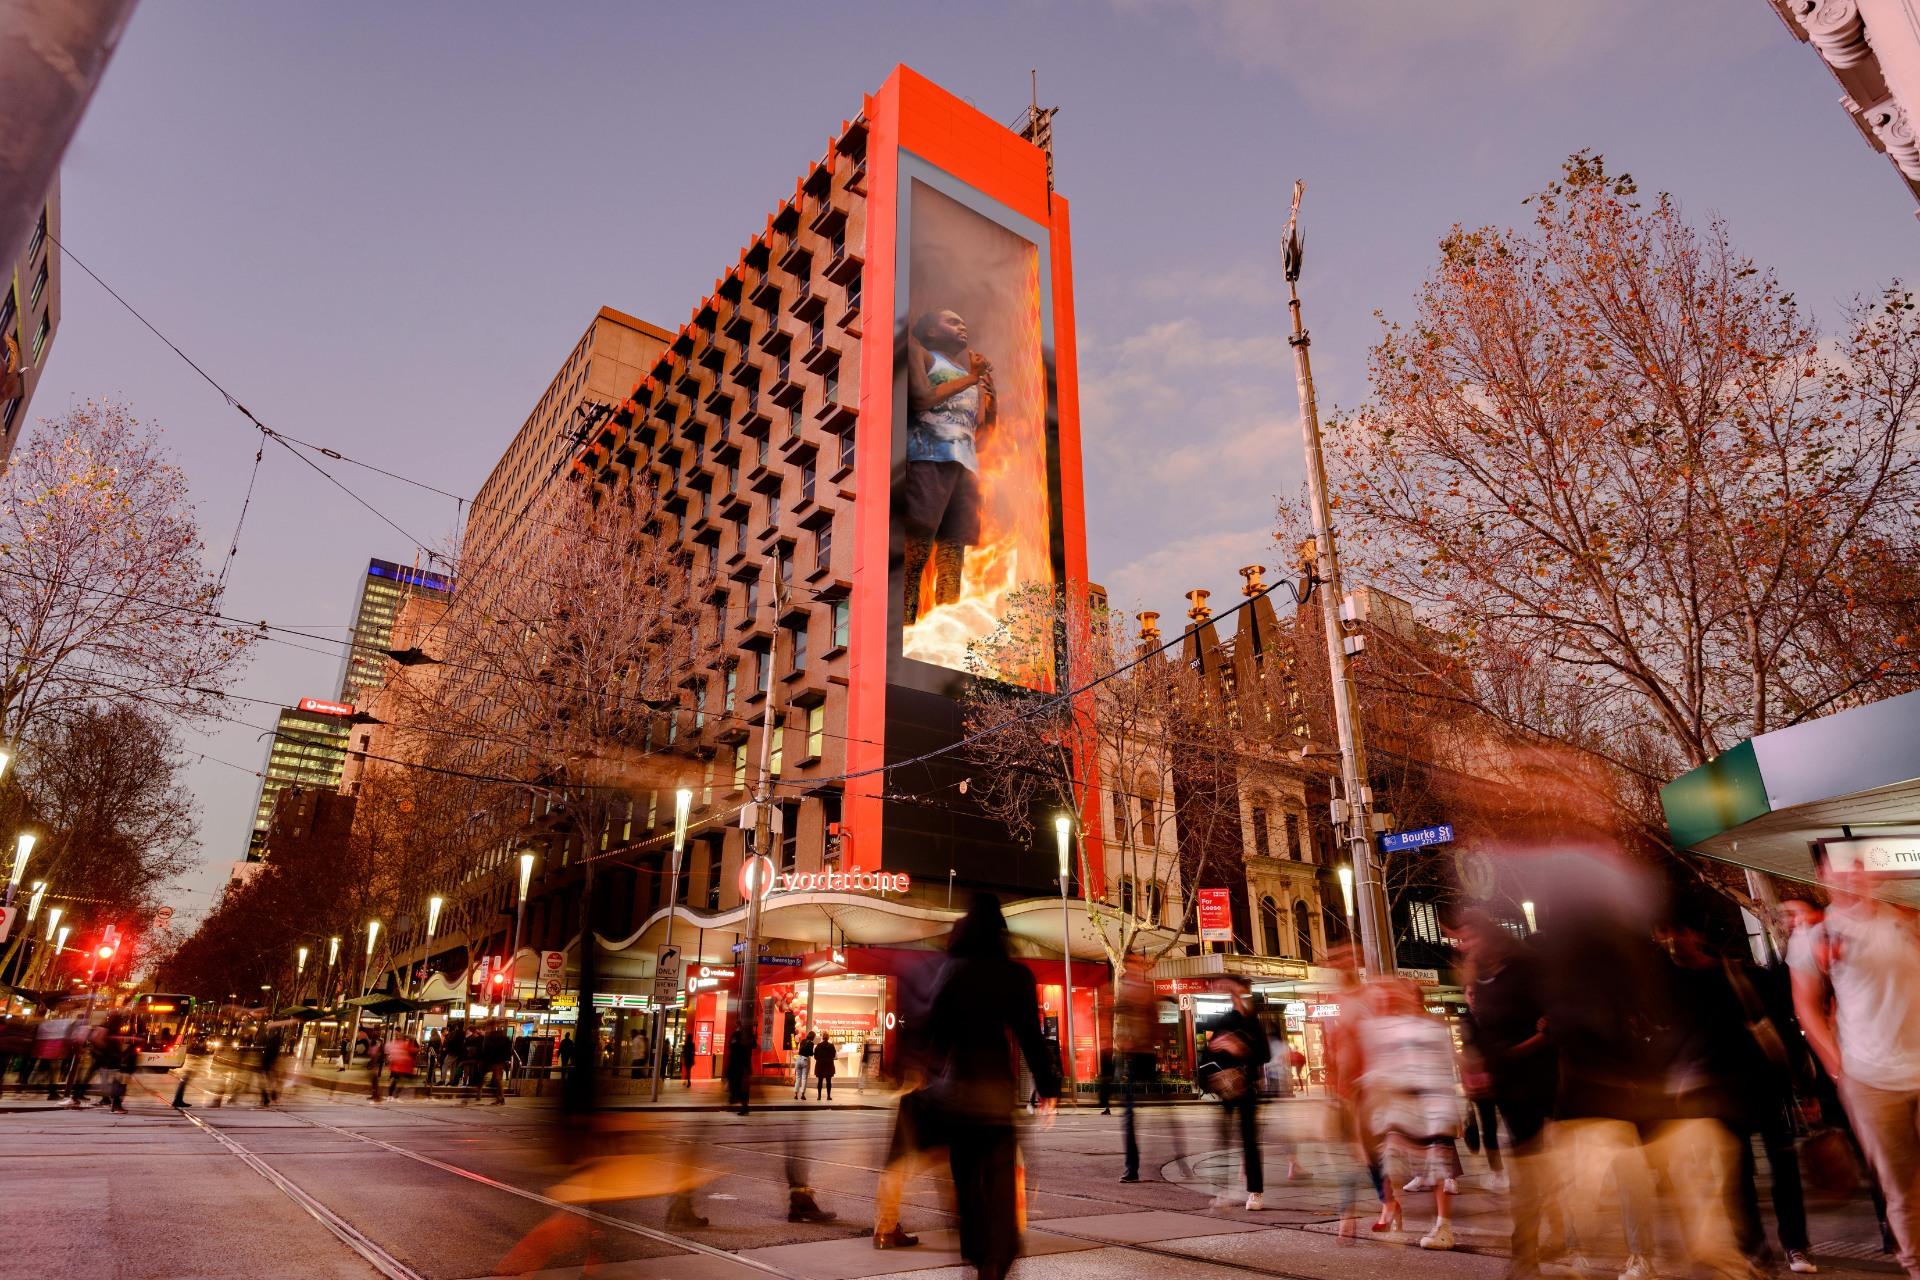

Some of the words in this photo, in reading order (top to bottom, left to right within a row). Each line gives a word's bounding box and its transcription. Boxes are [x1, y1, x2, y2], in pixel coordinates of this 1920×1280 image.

[1402, 829, 1435, 843] Bourke
[1439, 826, 1449, 837] St
[782, 864, 911, 892] vodafone
